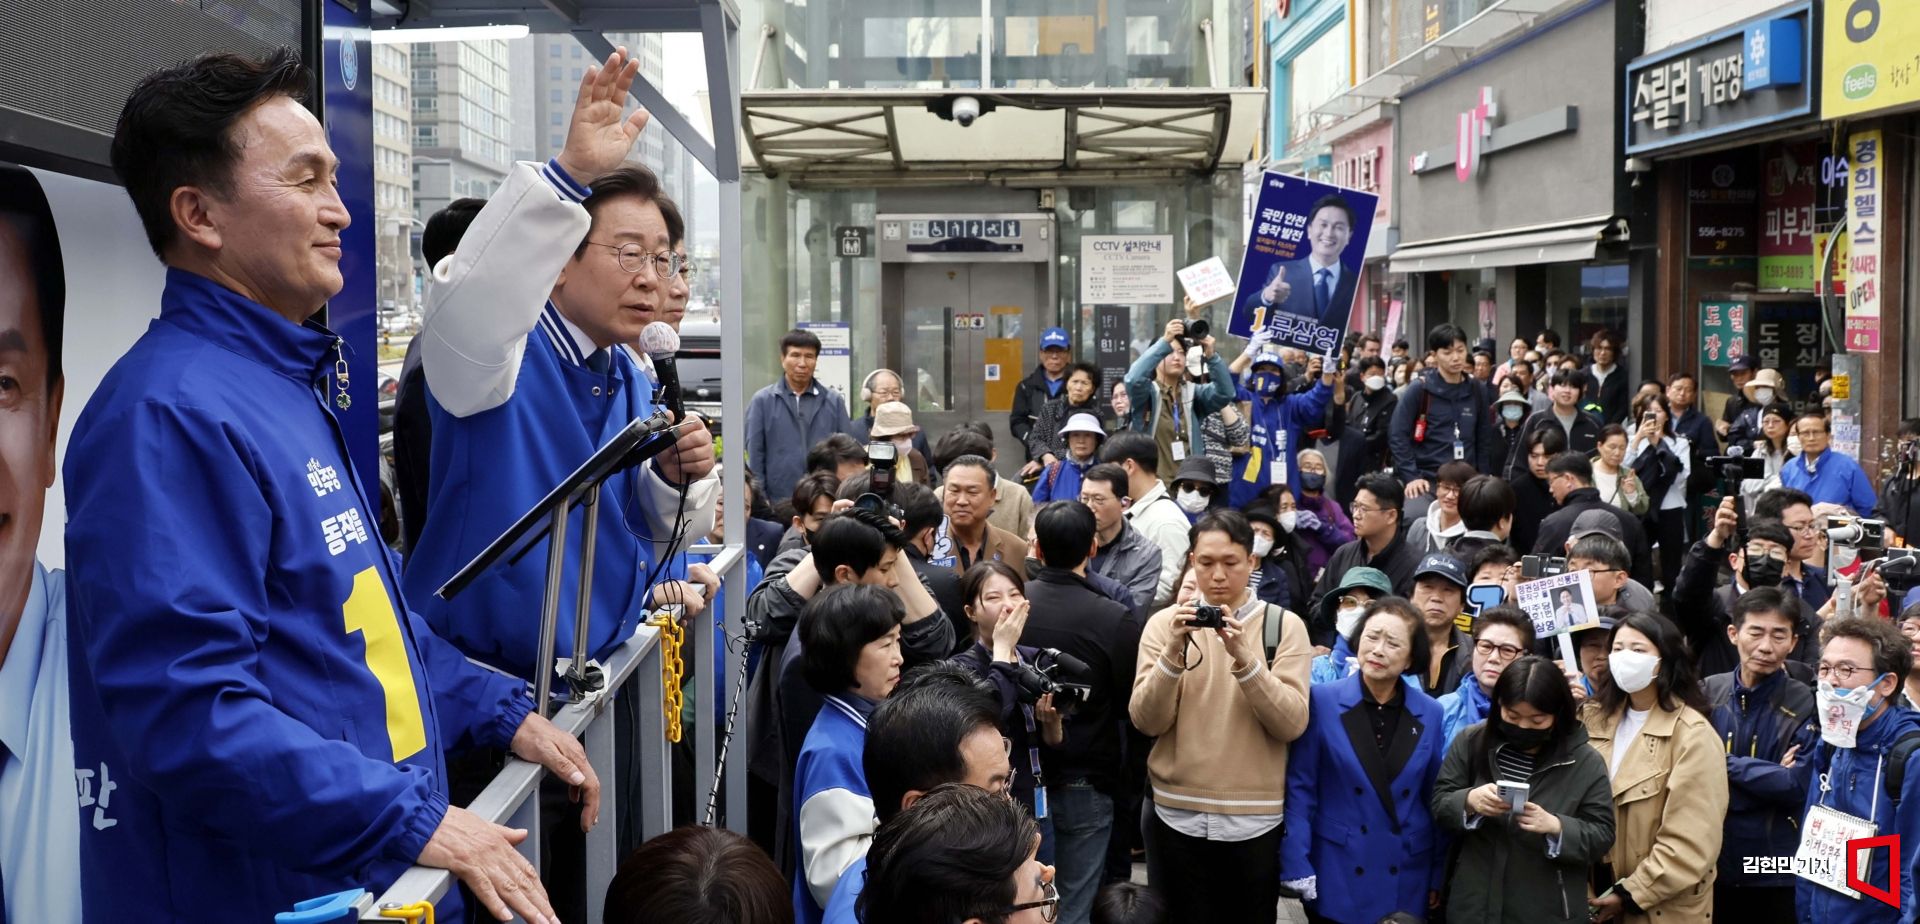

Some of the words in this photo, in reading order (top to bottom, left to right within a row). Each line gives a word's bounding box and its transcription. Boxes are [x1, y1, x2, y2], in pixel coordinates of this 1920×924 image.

[1633, 58, 1690, 130] 스릴러
[1697, 52, 1744, 107] 게임장
[1844, 70, 1876, 95] feels
[1854, 138, 1876, 245] 경희헬스
[1262, 207, 1285, 222] 국민
[1285, 212, 1307, 228] 안전
[1766, 203, 1816, 246] 피부과
[1258, 221, 1281, 237] 동작
[1281, 227, 1304, 242] 발전
[1093, 241, 1120, 251] CCTV
[1122, 240, 1161, 252] 설치안내
[1851, 279, 1876, 309] OPEN
[1250, 305, 1267, 332] 1
[1269, 314, 1339, 349] 류삼영
[1101, 338, 1113, 349] B1
[1557, 573, 1579, 586] 선봉대
[1535, 619, 1556, 633] 삼영
[342, 565, 427, 764] 1
